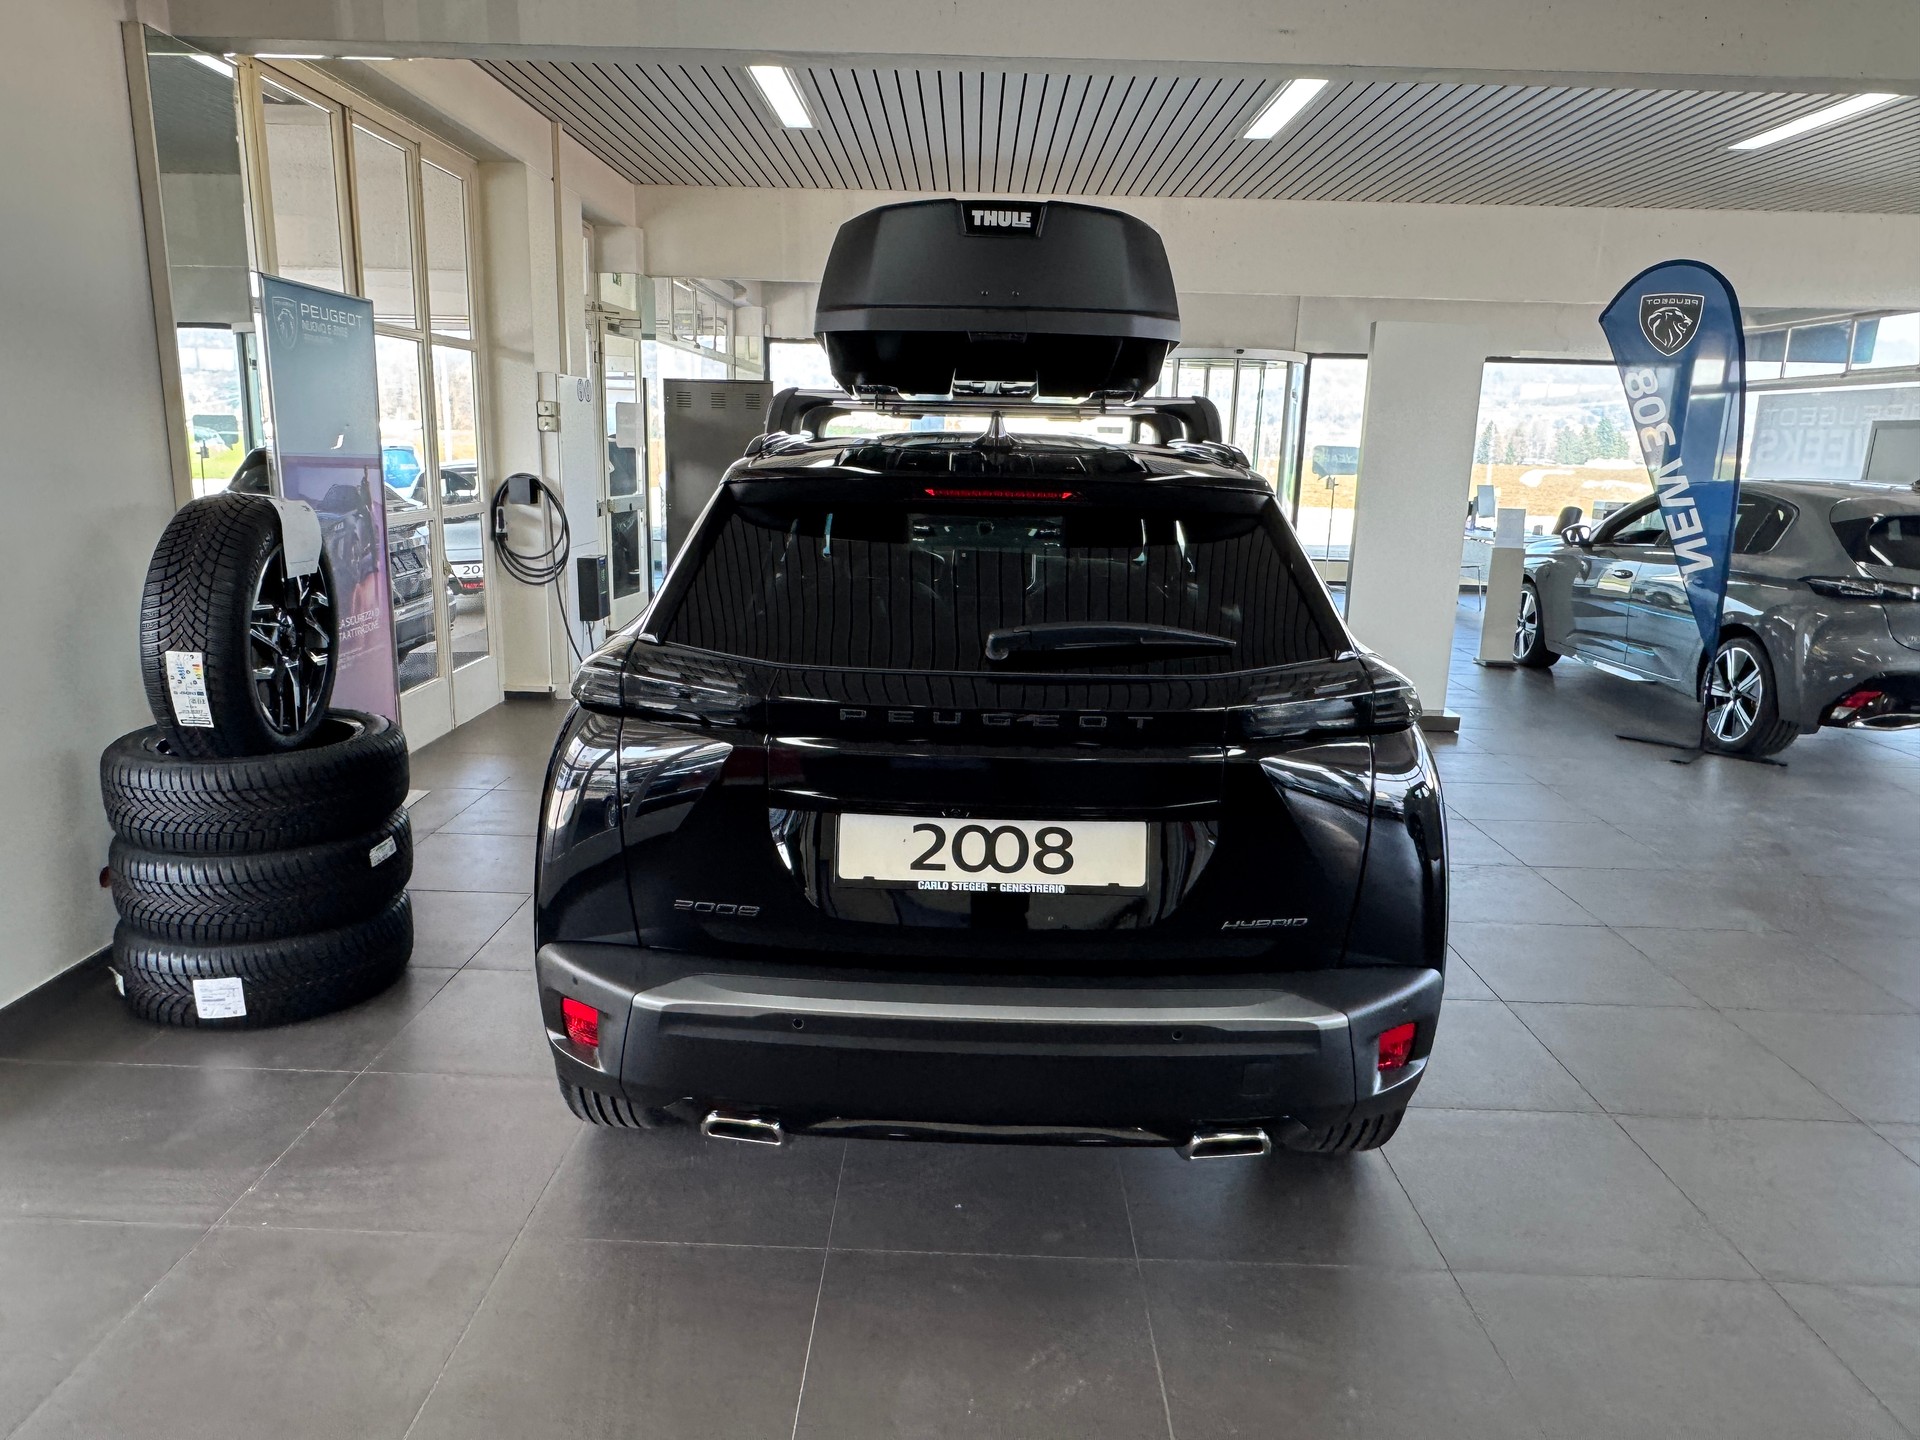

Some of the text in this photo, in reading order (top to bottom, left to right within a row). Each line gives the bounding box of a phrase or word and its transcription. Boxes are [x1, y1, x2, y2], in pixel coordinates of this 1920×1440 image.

[972, 210, 1032, 228] THULE
[300, 302, 363, 329] PEUGEOT
[463, 565, 483, 576] 20
[839, 708, 1154, 730] PEUGEOT
[909, 823, 1075, 876] 2008
[917, 880, 949, 891] CARLO
[951, 881, 988, 892] STEGER
[999, 884, 1066, 894] GENESTRERIO
[674, 899, 760, 916] 2008
[1221, 917, 1308, 930] HYBRID
